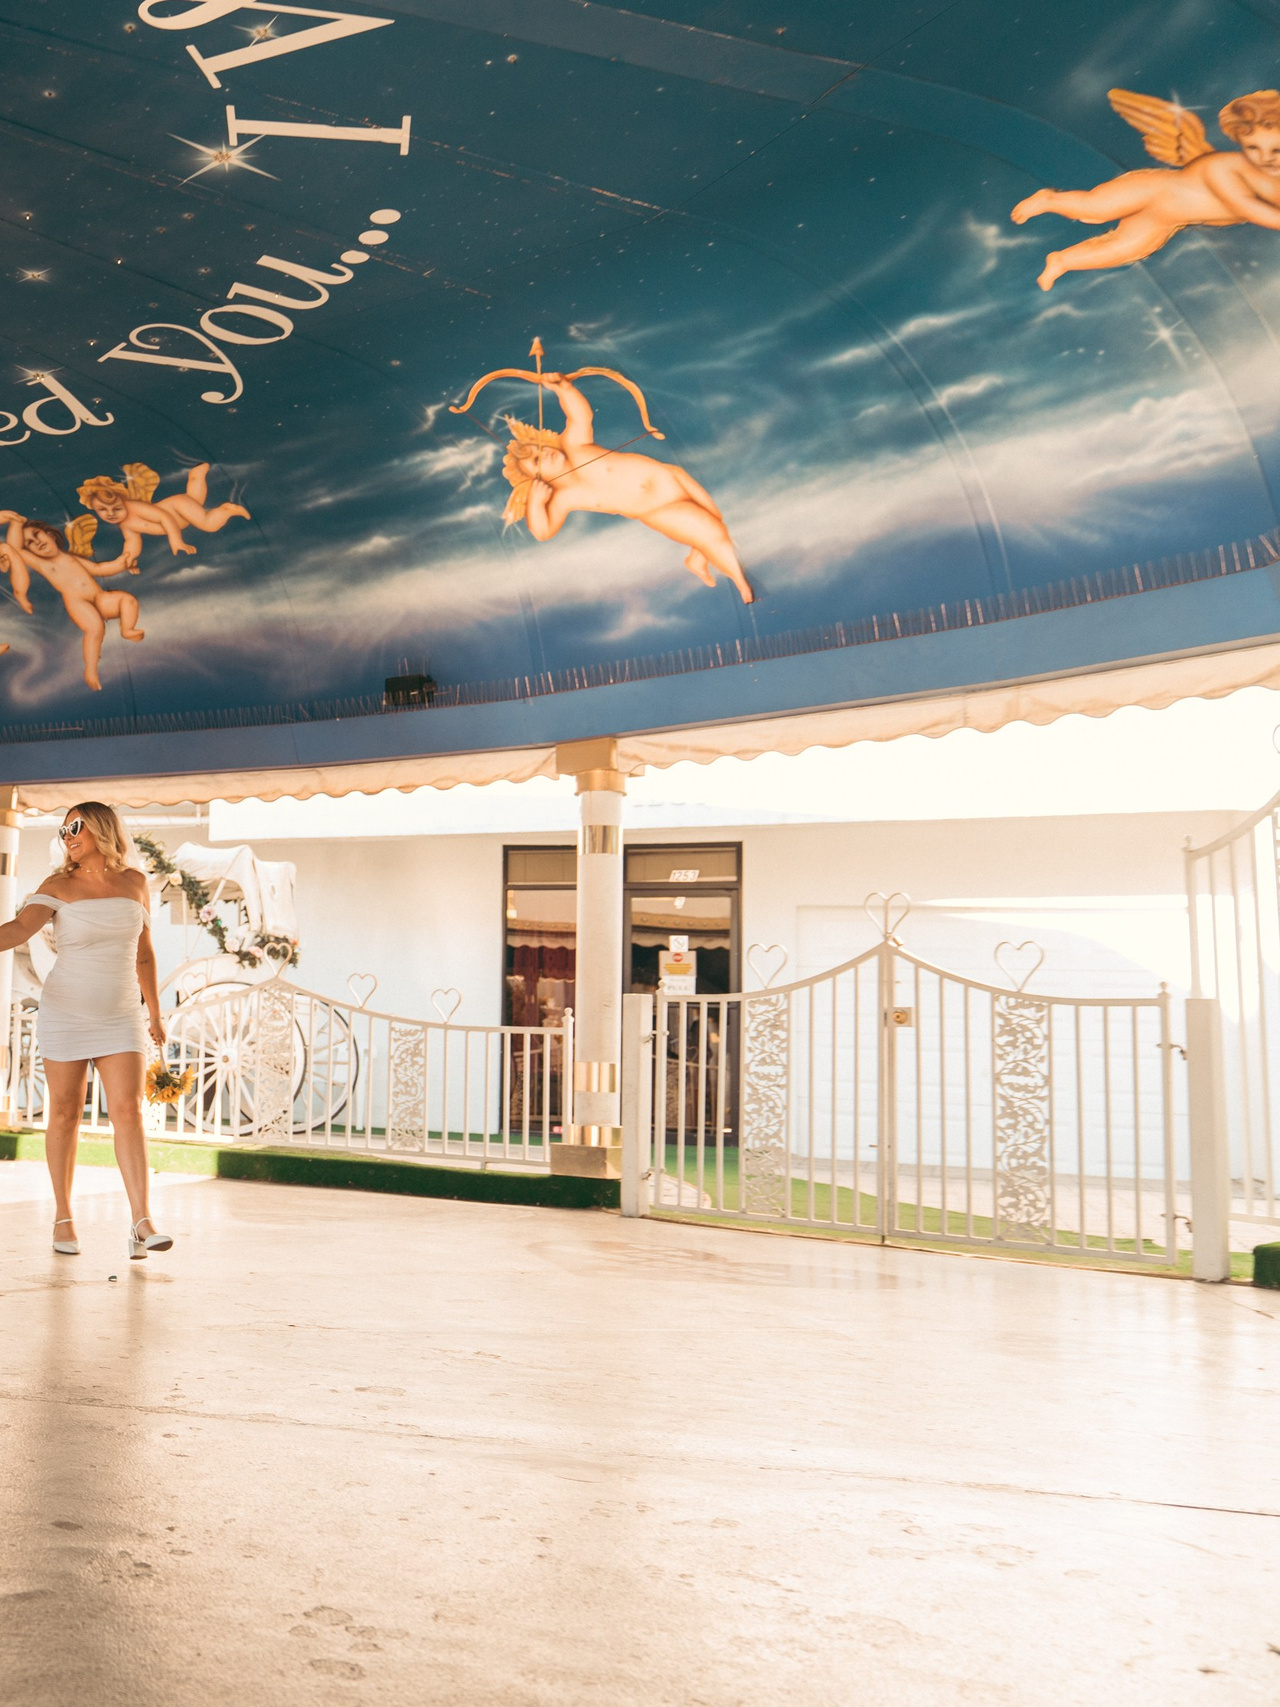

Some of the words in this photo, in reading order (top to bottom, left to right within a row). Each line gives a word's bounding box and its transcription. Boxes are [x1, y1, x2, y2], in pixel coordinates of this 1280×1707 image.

[226, 104, 411, 156] I
[97, 209, 401, 404] you...
[672, 871, 696, 881] 1253
